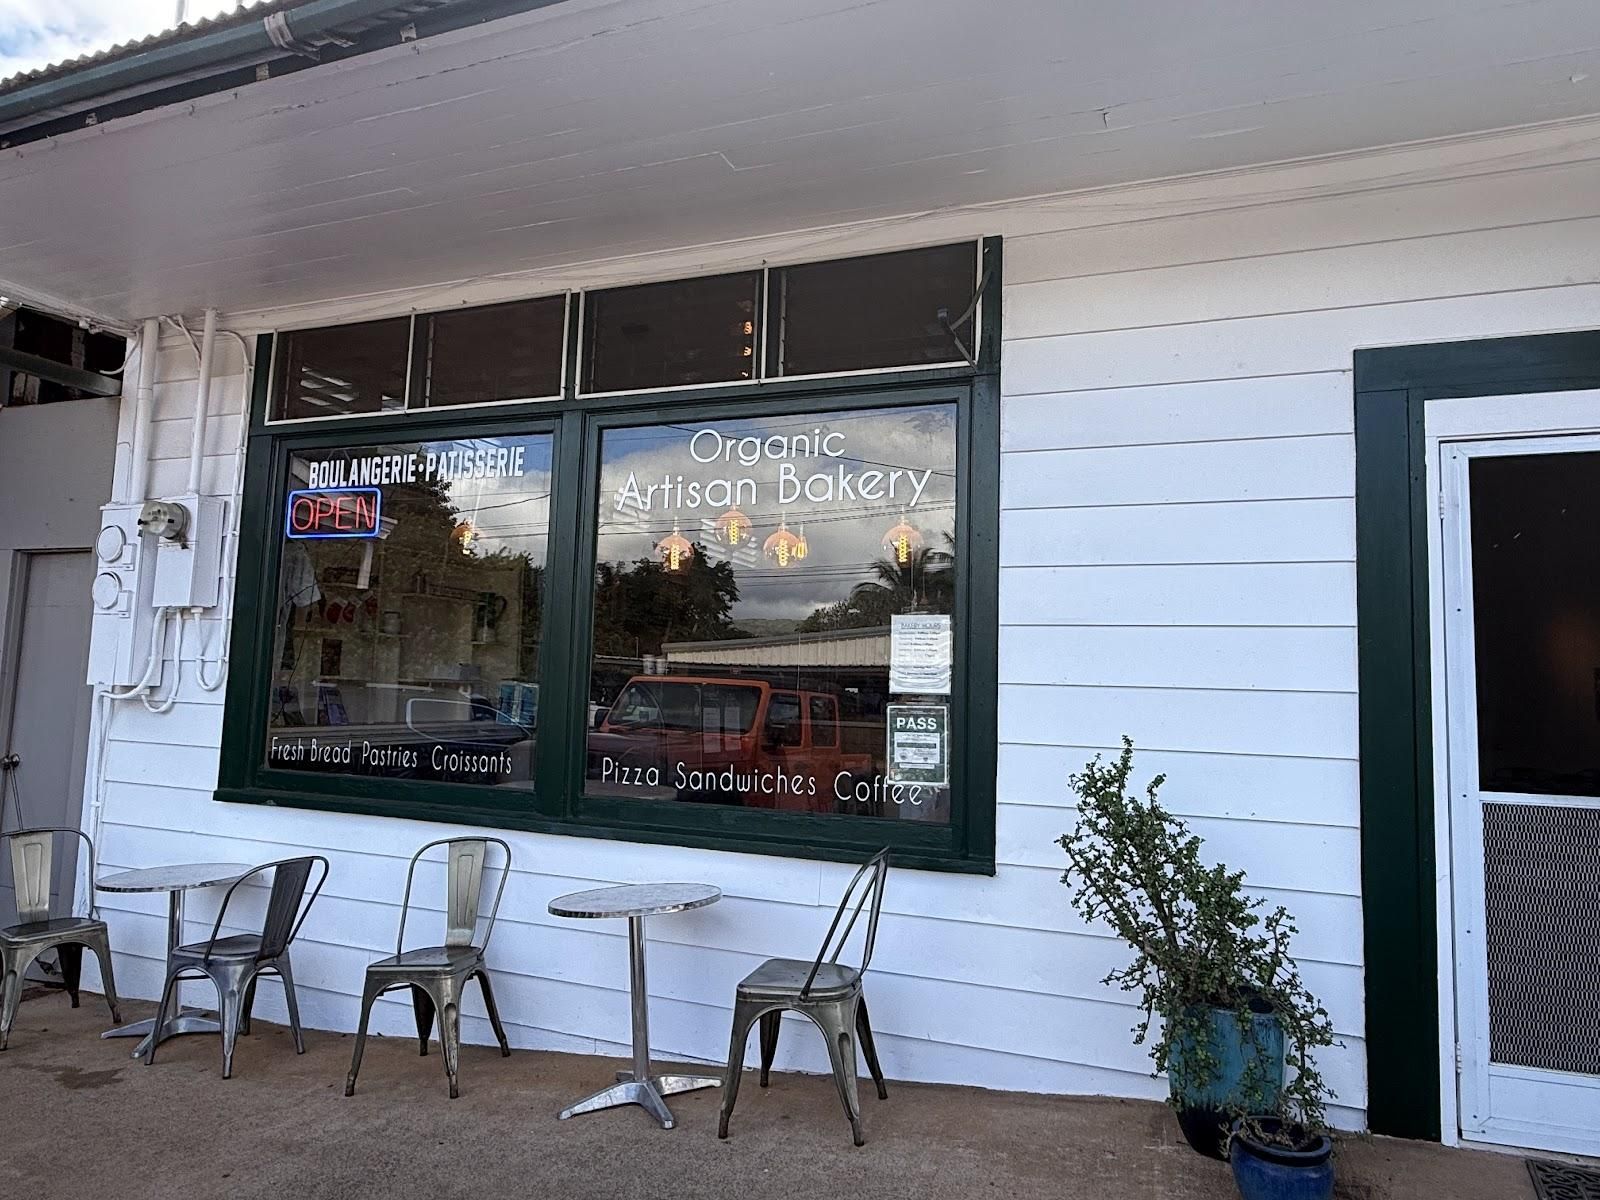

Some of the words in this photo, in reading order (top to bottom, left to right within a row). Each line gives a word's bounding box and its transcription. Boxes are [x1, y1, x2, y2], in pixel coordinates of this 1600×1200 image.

[690, 428, 846, 467] Organic
[616, 471, 758, 511] Artisan
[778, 463, 933, 507] Bakery
[291, 495, 377, 531] OPEN
[896, 717, 937, 730] PASS
[271, 737, 305, 762] Fresh
[310, 738, 351, 764] Bread
[362, 741, 418, 769] Pastries
[431, 745, 513, 775] Croissants
[602, 757, 660, 787] Pizza
[675, 762, 817, 796] Sandwiches
[834, 771, 923, 806] Coffee
